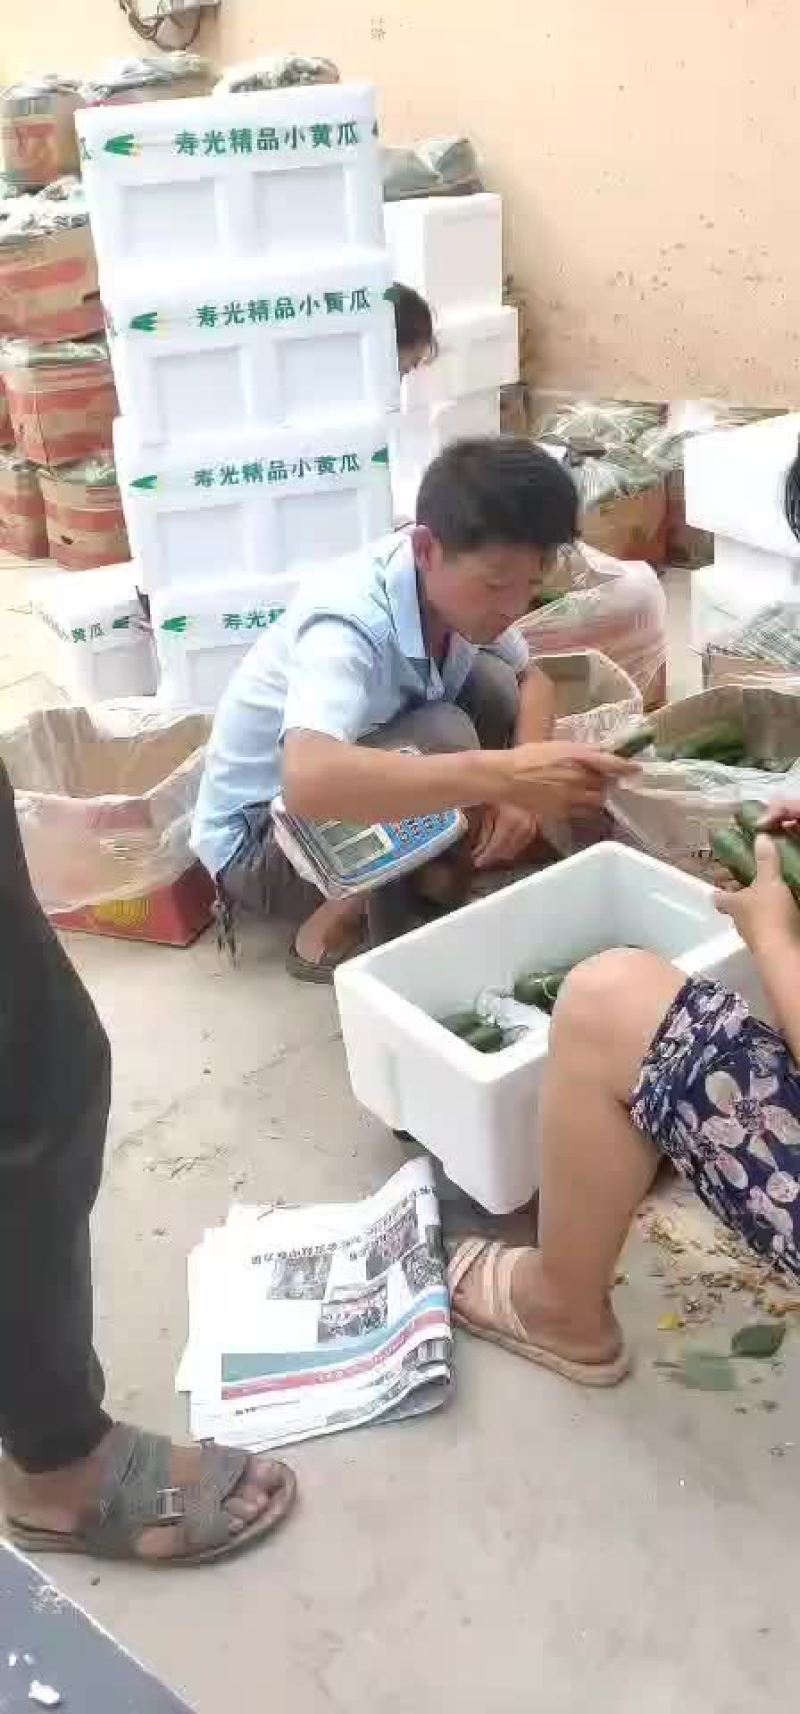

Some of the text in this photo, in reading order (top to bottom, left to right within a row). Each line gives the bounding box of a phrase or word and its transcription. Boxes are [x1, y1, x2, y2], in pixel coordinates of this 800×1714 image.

[174, 120, 358, 156] 寿光精品小黄瓜
[196, 287, 371, 328] 寿光精品小黄瓜
[194, 453, 360, 487] 寿光精品小黄瓜
